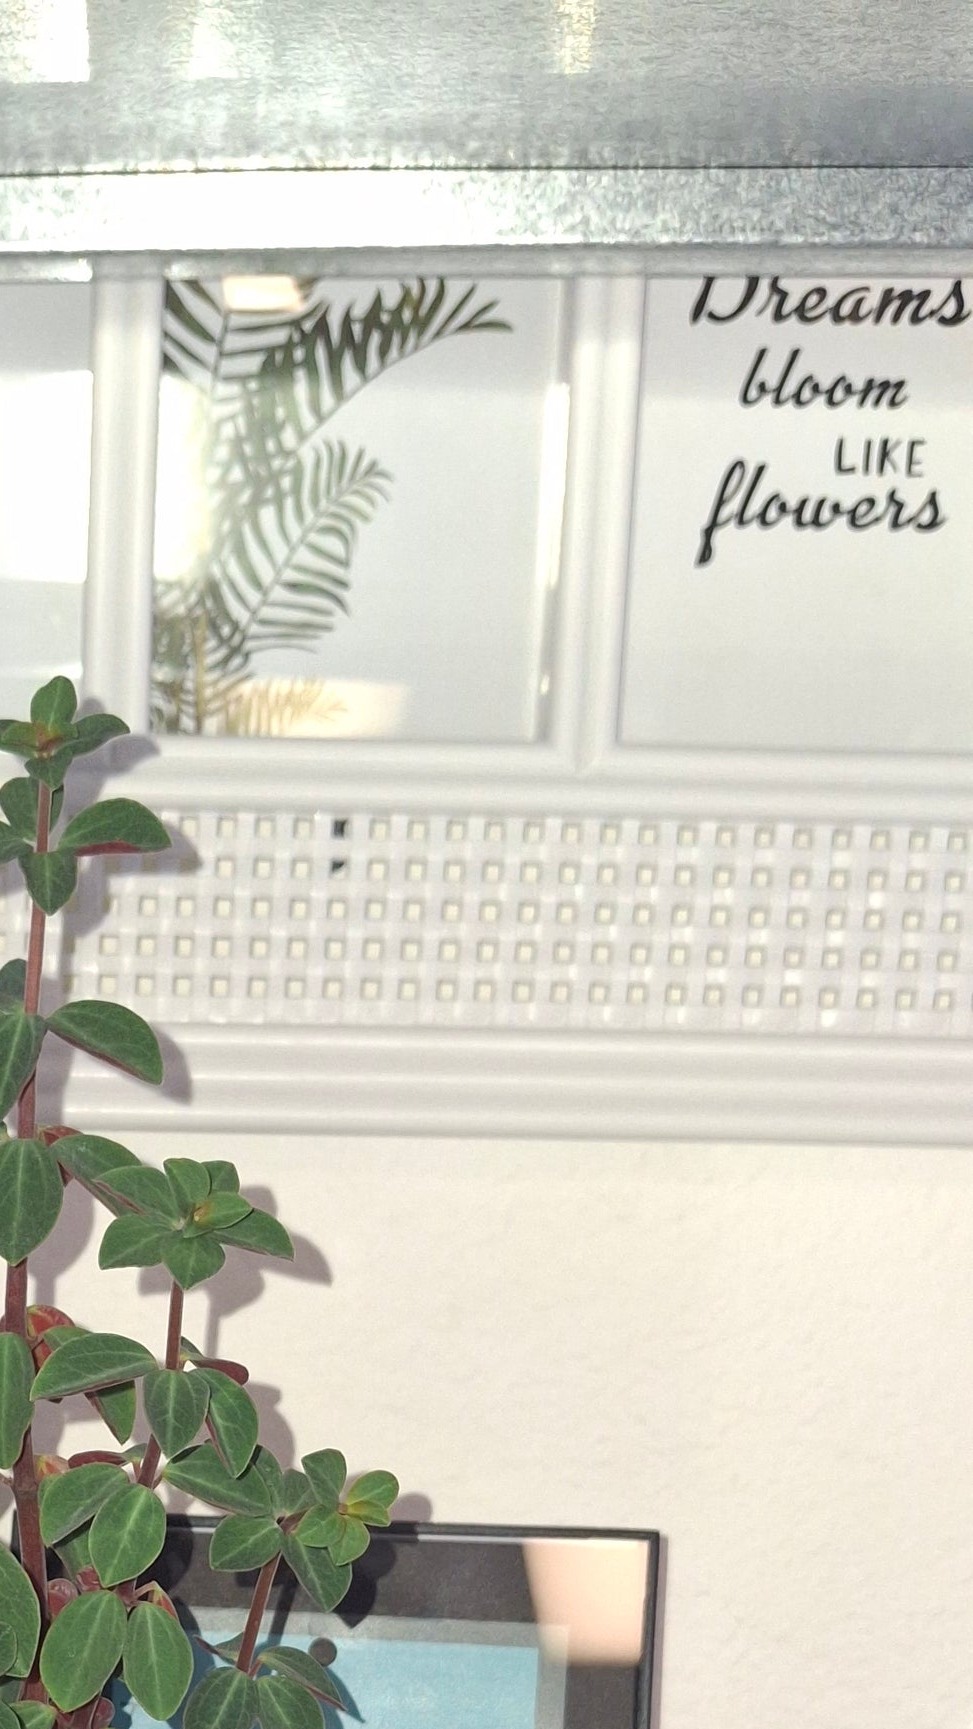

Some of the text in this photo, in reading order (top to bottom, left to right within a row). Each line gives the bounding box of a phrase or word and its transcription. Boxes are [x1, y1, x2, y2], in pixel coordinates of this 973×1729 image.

[689, 275, 971, 326] Dreams
[739, 347, 909, 409] bloom
[833, 436, 926, 477] LIKE
[694, 457, 945, 567] flowers
